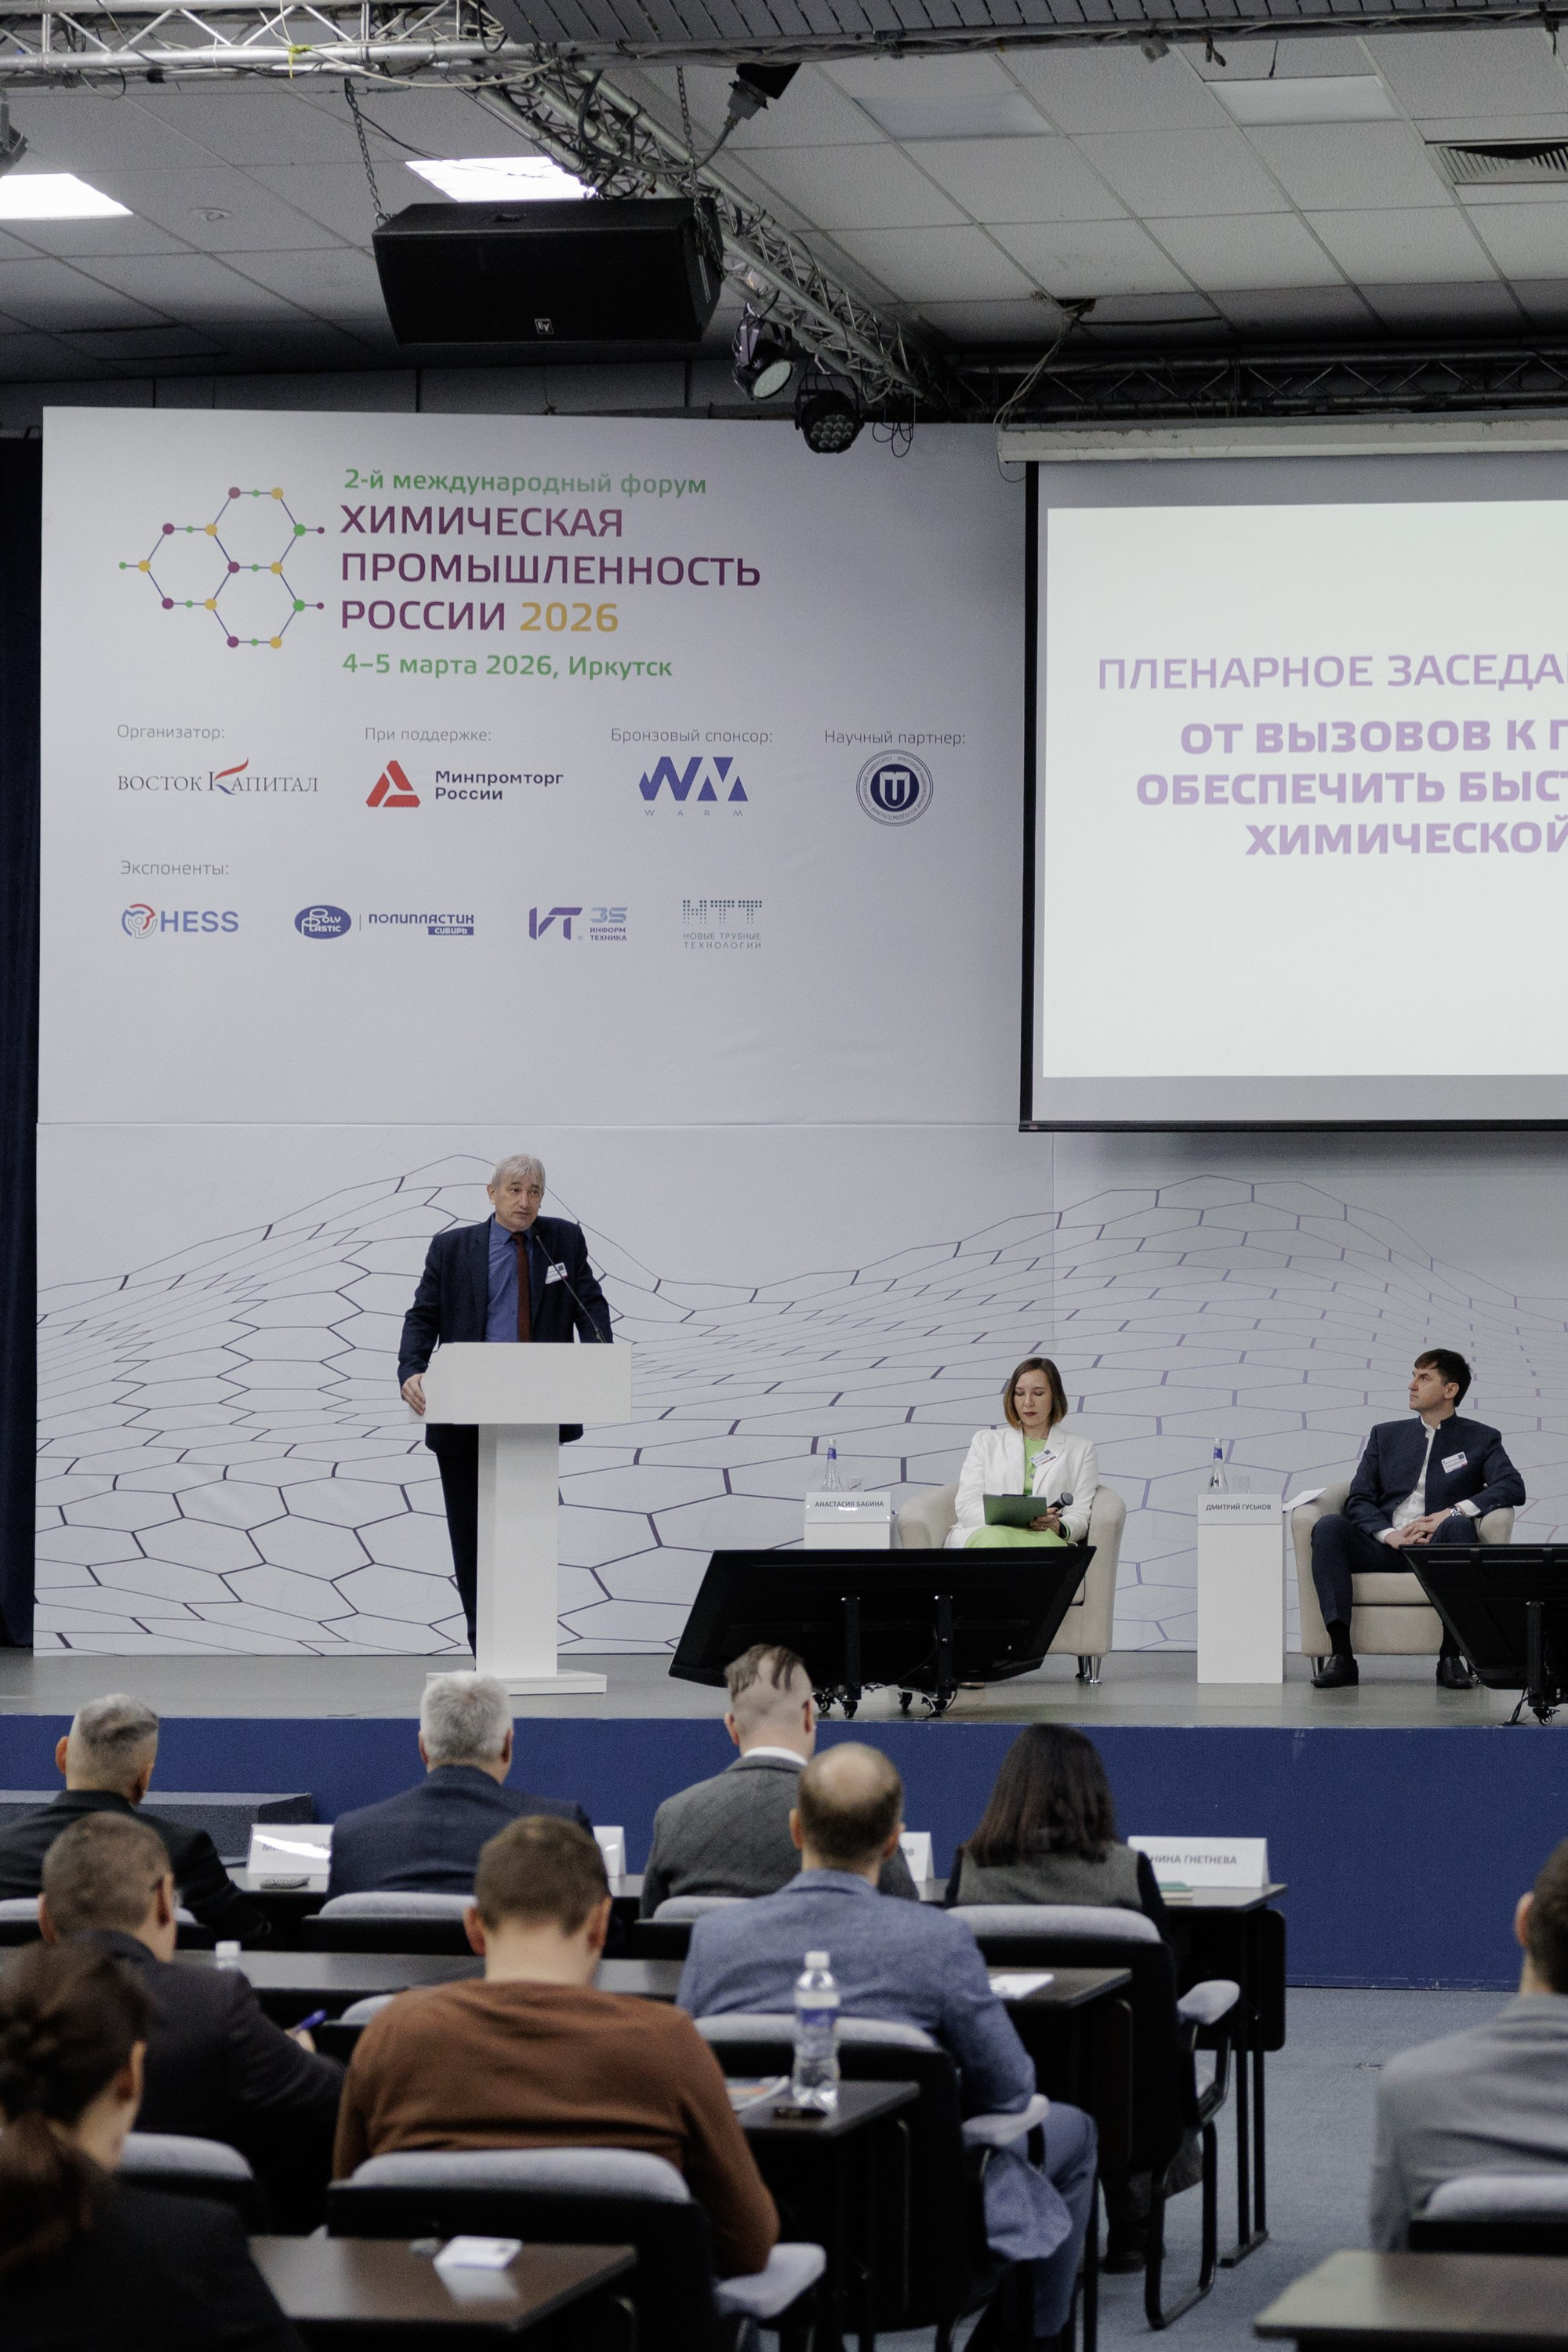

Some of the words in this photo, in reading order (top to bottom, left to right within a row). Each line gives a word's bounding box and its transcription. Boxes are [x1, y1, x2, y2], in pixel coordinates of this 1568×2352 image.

[344, 468, 383, 489] 2-й
[393, 471, 612, 495] международный
[621, 474, 706, 498] форум
[340, 505, 622, 537] ХИМИЧЕСКАЯ
[343, 553, 760, 586] ПРОМЫШЛЕННОСТЬ
[343, 600, 505, 630] РОССИИ
[520, 601, 619, 633] 2026
[400, 659, 477, 679] марта
[486, 655, 559, 680] 2026,
[569, 655, 673, 681] Иркутск
[1099, 655, 1373, 690] ПЛЕНАРНОЕ
[1388, 653, 1568, 691] ЗАСЕДА
[117, 724, 225, 742] Организатор:
[365, 727, 395, 743] При
[401, 730, 492, 744] поддержке:
[611, 728, 700, 744] Бронзовый
[705, 731, 773, 746] спонсор:
[825, 730, 893, 747] Научный
[898, 733, 966, 747] партнер:
[1180, 723, 1243, 754] ОТ
[1257, 720, 1491, 753] ВЫЗОВОВ
[1507, 720, 1537, 750] К
[118, 775, 202, 792] ВОСТОК
[208, 757, 319, 796] КАПИТАЛ
[435, 770, 564, 786] Минпромторг
[435, 786, 503, 800] России
[1137, 771, 1446, 806] ОБЕСПЕЧИТЬ
[1245, 814, 1568, 855] ХИМИЧЕСКОЙ
[120, 859, 229, 876] Экспоненты:
[160, 910, 239, 933] HESS
[368, 913, 474, 924] ПОЛИПЛАСТИК
[683, 932, 715, 941] НОВЫЕ
[720, 932, 761, 941] ТРУБНЫЕ
[1206, 1503, 1240, 1512] ДМИТРИЙ
[1184, 1855, 1237, 1864] ГНЕТНЕВА
